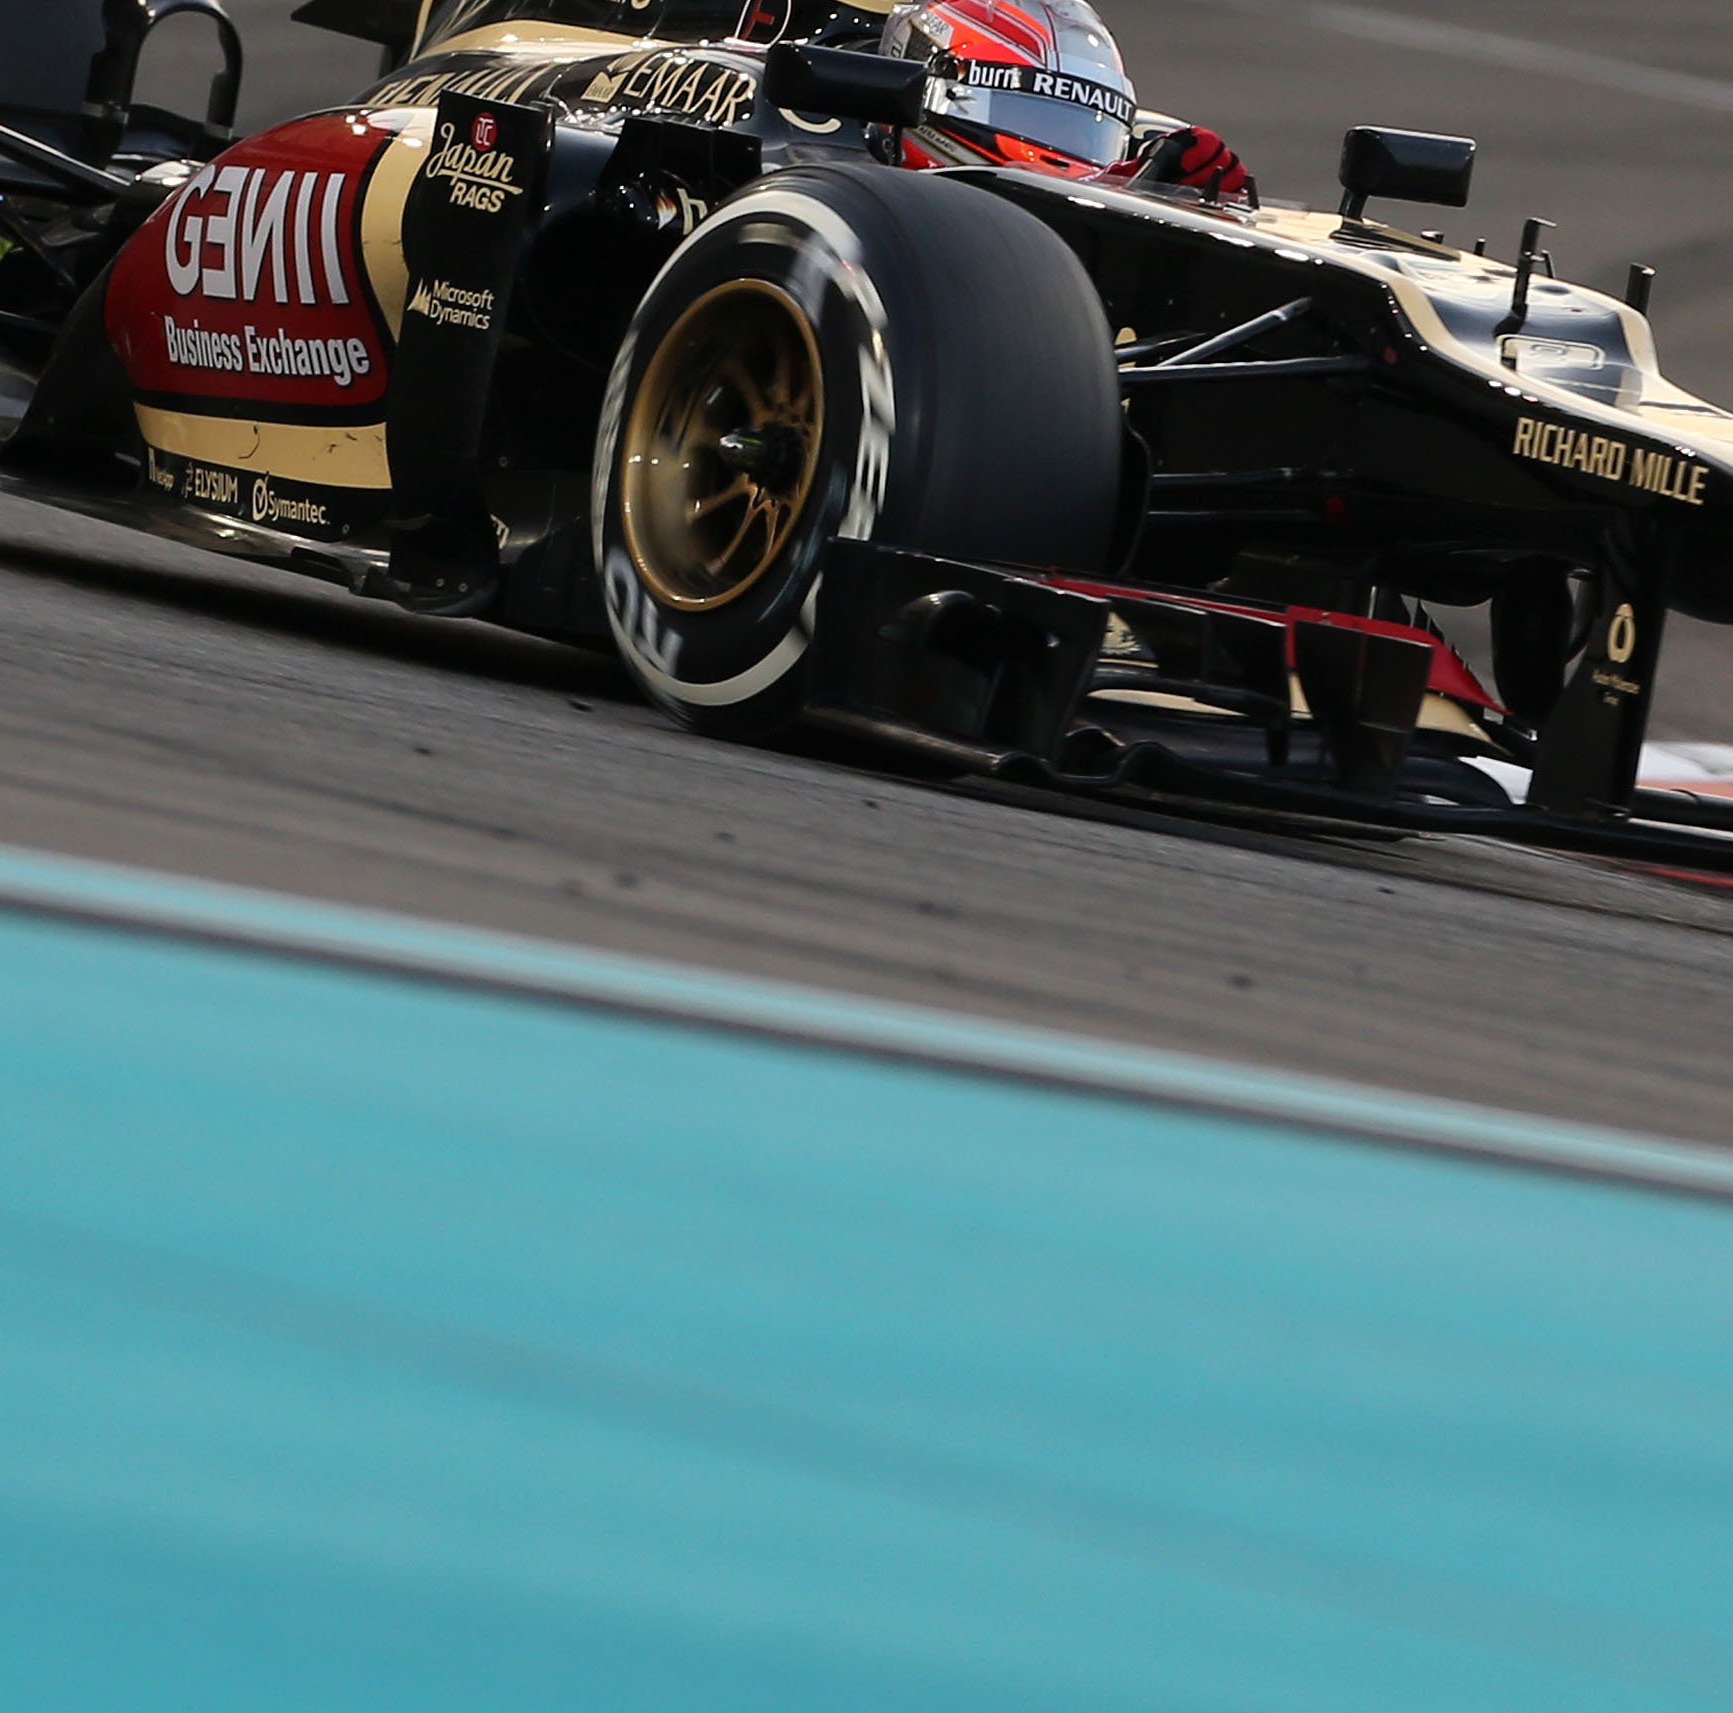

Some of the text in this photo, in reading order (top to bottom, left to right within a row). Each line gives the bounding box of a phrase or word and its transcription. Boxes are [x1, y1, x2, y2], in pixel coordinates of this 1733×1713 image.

[622, 52, 758, 127] EMAAR
[969, 60, 1135, 122] burn RENAULT
[425, 122, 515, 187] Japan
[449, 181, 506, 213] RAGS
[165, 164, 350, 305] GENII
[429, 299, 491, 330] Dynamics
[432, 279, 495, 311] Microsoft
[164, 315, 370, 386] Business Exchange
[194, 467, 239, 504] ELYSIUM
[1512, 416, 1710, 505] RICHARD MILLE
